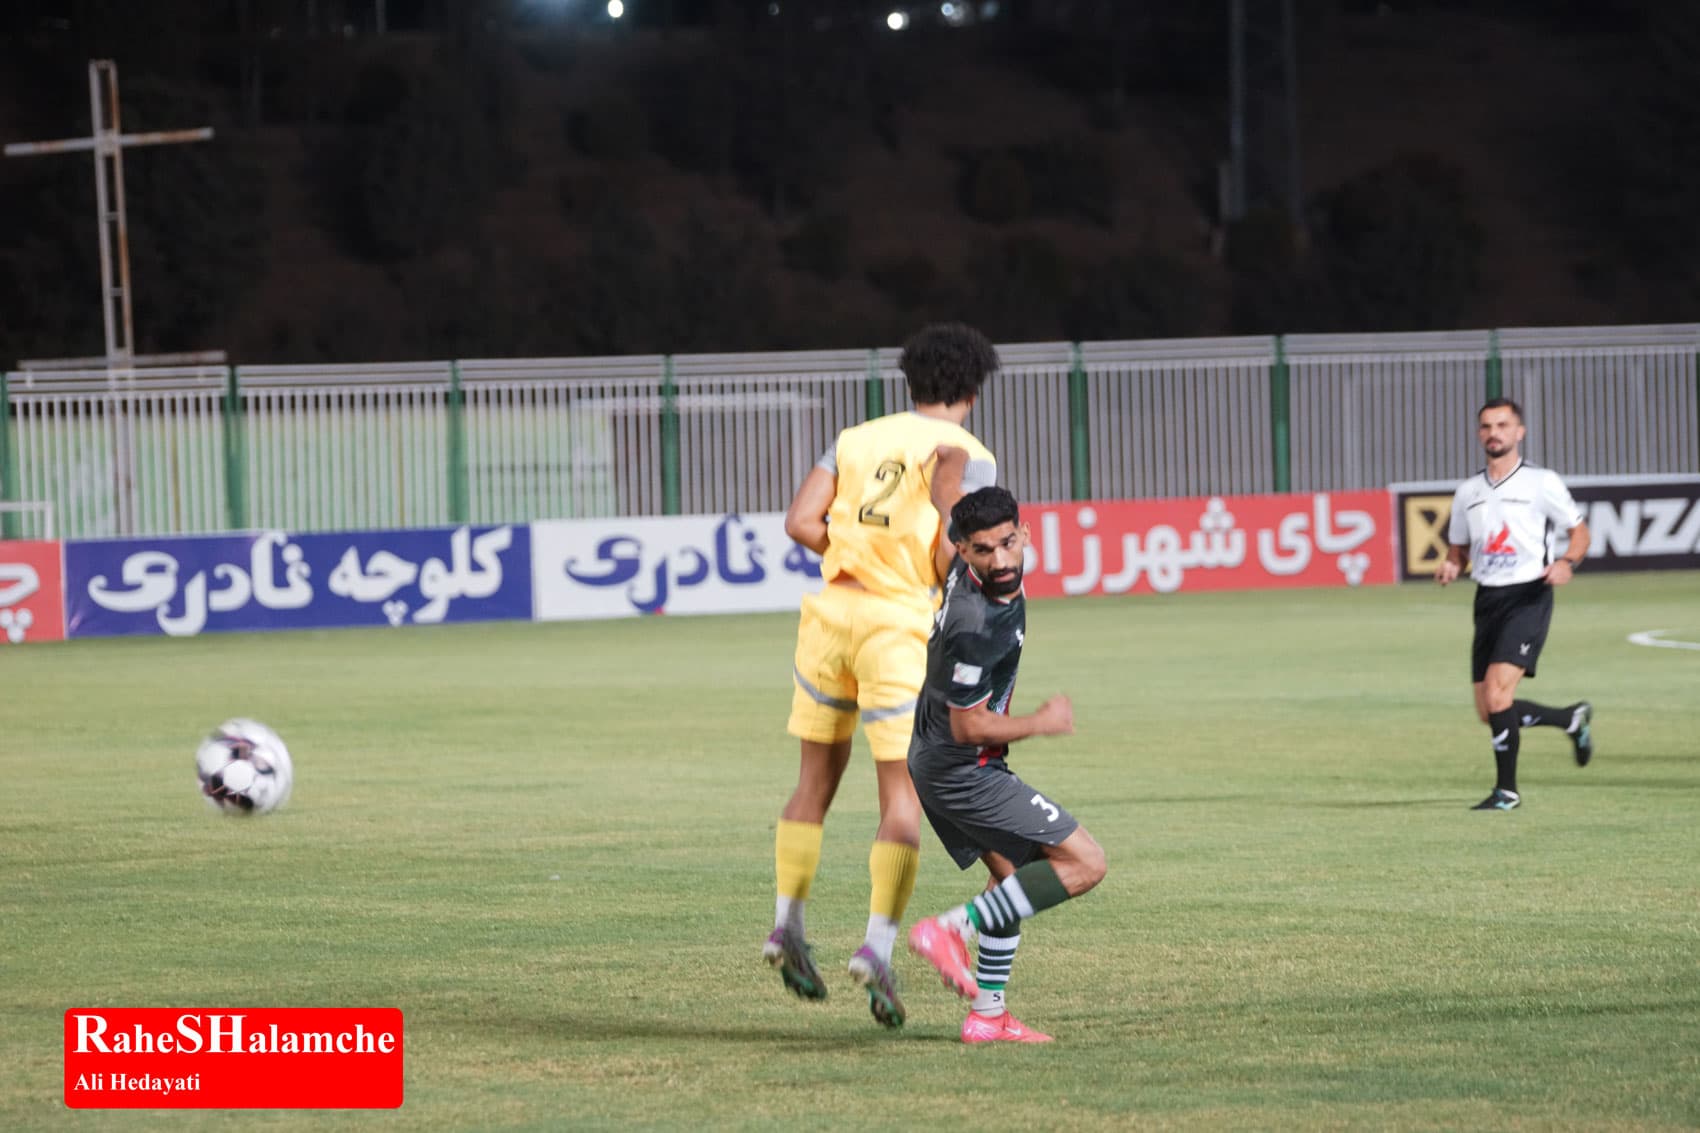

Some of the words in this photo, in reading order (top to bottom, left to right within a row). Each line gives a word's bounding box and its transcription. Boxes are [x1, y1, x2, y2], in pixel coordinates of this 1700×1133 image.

[858, 460, 906, 528] 2
[1258, 493, 1376, 586] چای
[1553, 497, 1700, 558] NZ
[88, 529, 313, 636] نادری
[328, 525, 512, 627] کلوچه
[563, 512, 765, 615] نادری
[1030, 793, 1060, 822] 3
